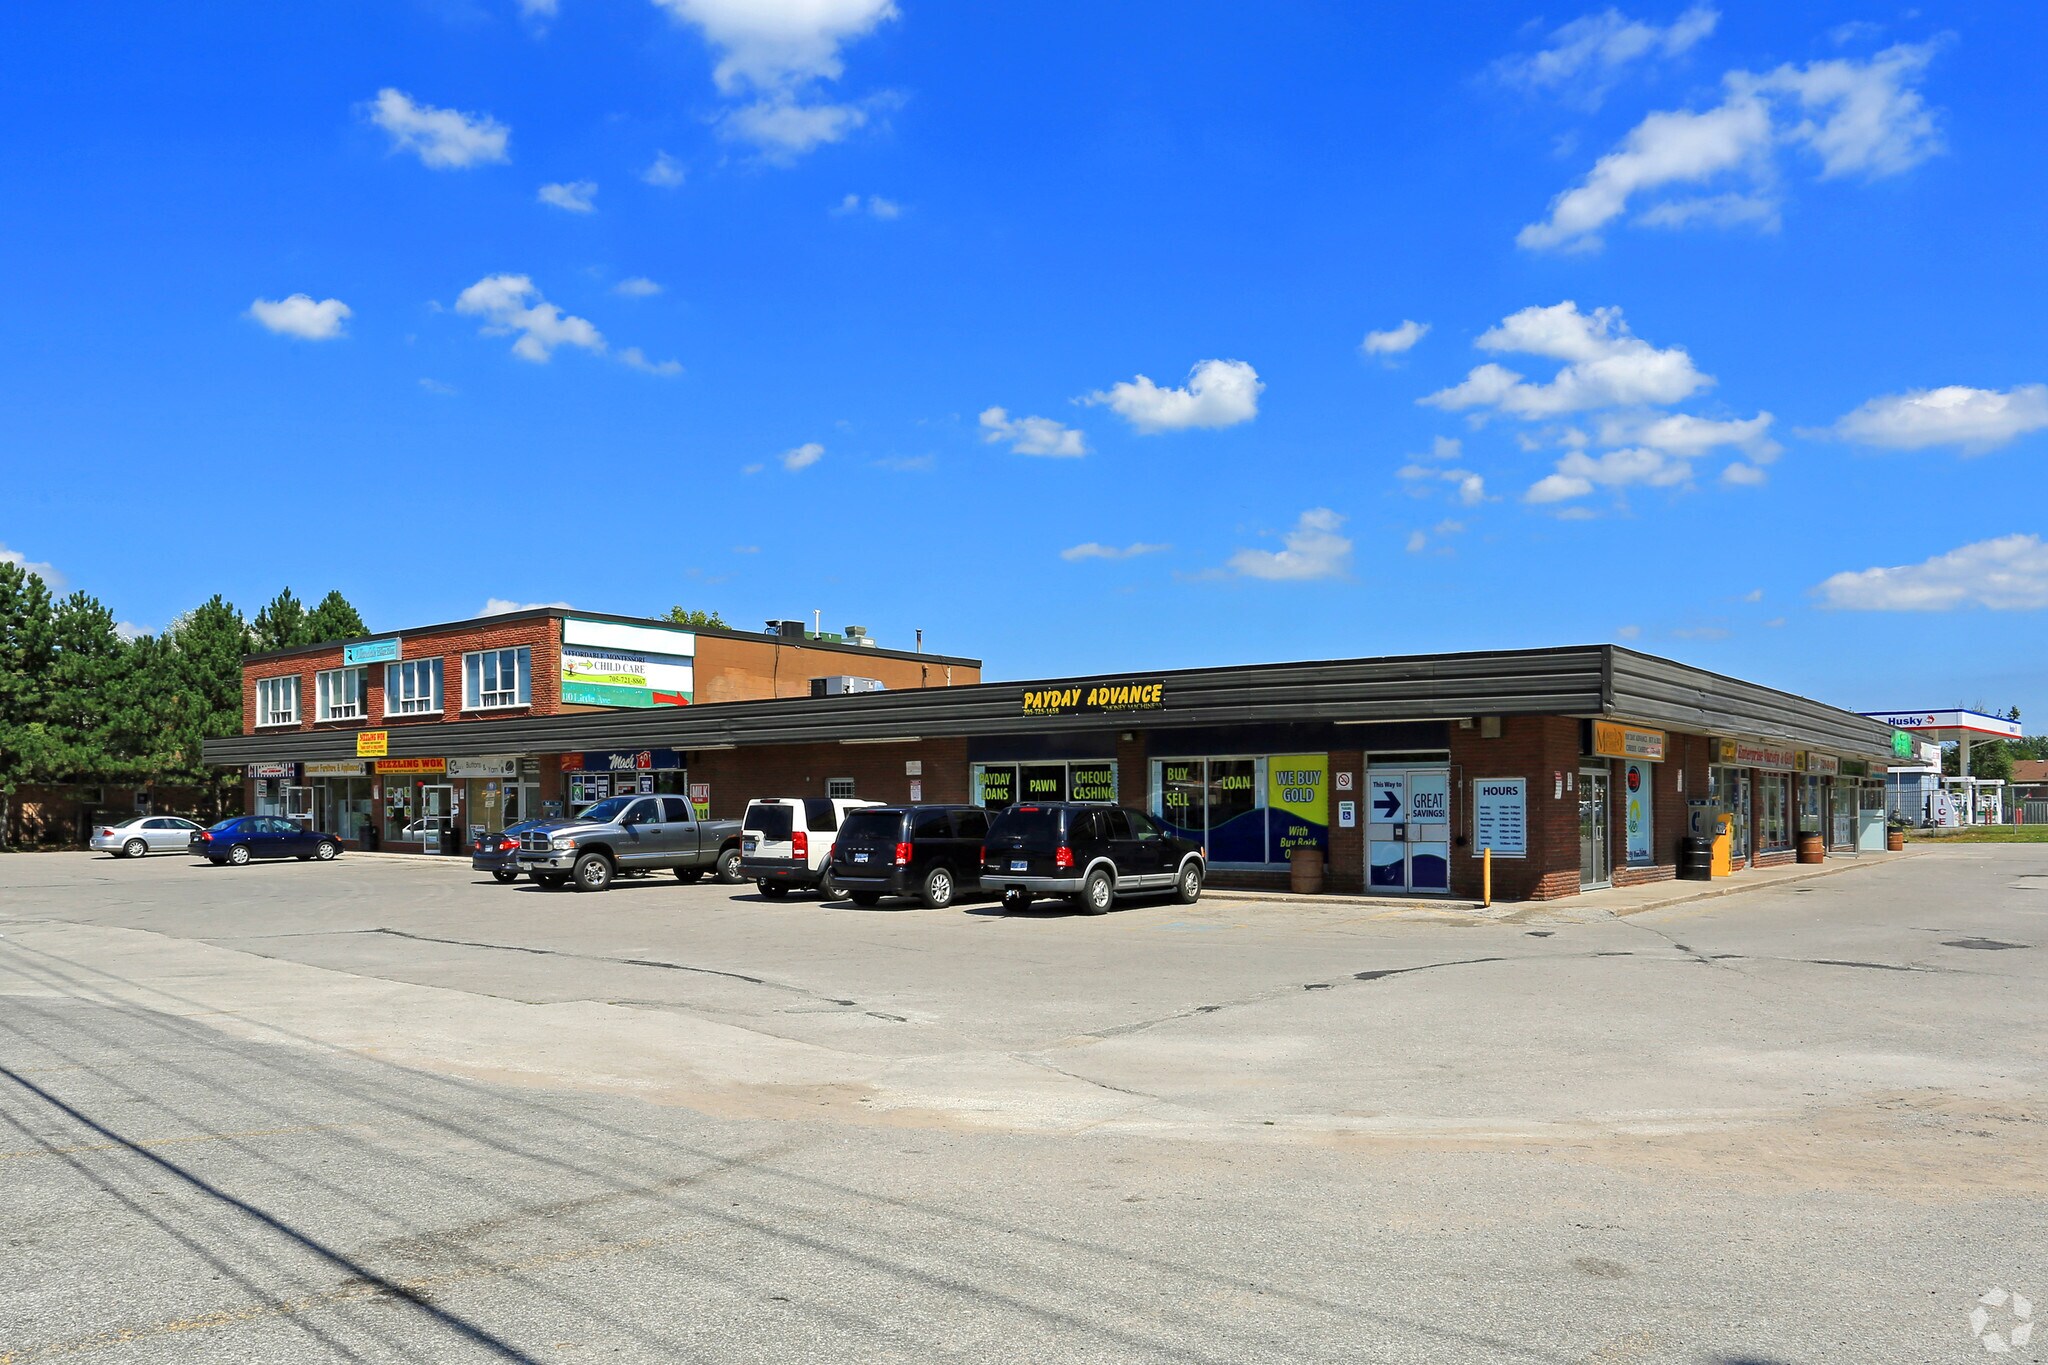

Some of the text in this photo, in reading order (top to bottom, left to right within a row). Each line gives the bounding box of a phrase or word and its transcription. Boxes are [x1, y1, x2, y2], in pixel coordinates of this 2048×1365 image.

[564, 650, 604, 659] AFFORDABLE
[594, 661, 646, 674] CHILD CARE
[1023, 684, 1163, 709] PAYDAY ADVANCE
[1888, 716, 1923, 726] Husky
[377, 758, 443, 769] SIZZLING WOK
[979, 773, 1011, 785] PAYDAY
[1075, 771, 1112, 784] CHEQUE
[1167, 767, 1189, 781] BUY
[1276, 771, 1321, 786] WE BUY
[1029, 780, 1057, 792] PAWN
[1222, 776, 1250, 790] LOAN
[1385, 781, 1396, 789] Way
[692, 785, 708, 798] MILK
[982, 787, 1009, 800] LOANS
[1073, 787, 1115, 799] CASHING
[1282, 788, 1314, 802] GOLD
[1483, 786, 1519, 796] HOURS
[1166, 792, 1190, 806] SELL
[1413, 793, 1444, 809] GREAT
[1413, 809, 1445, 818] SAVINGS!
[1938, 799, 1946, 825] ICE
[1288, 825, 1309, 836] With
